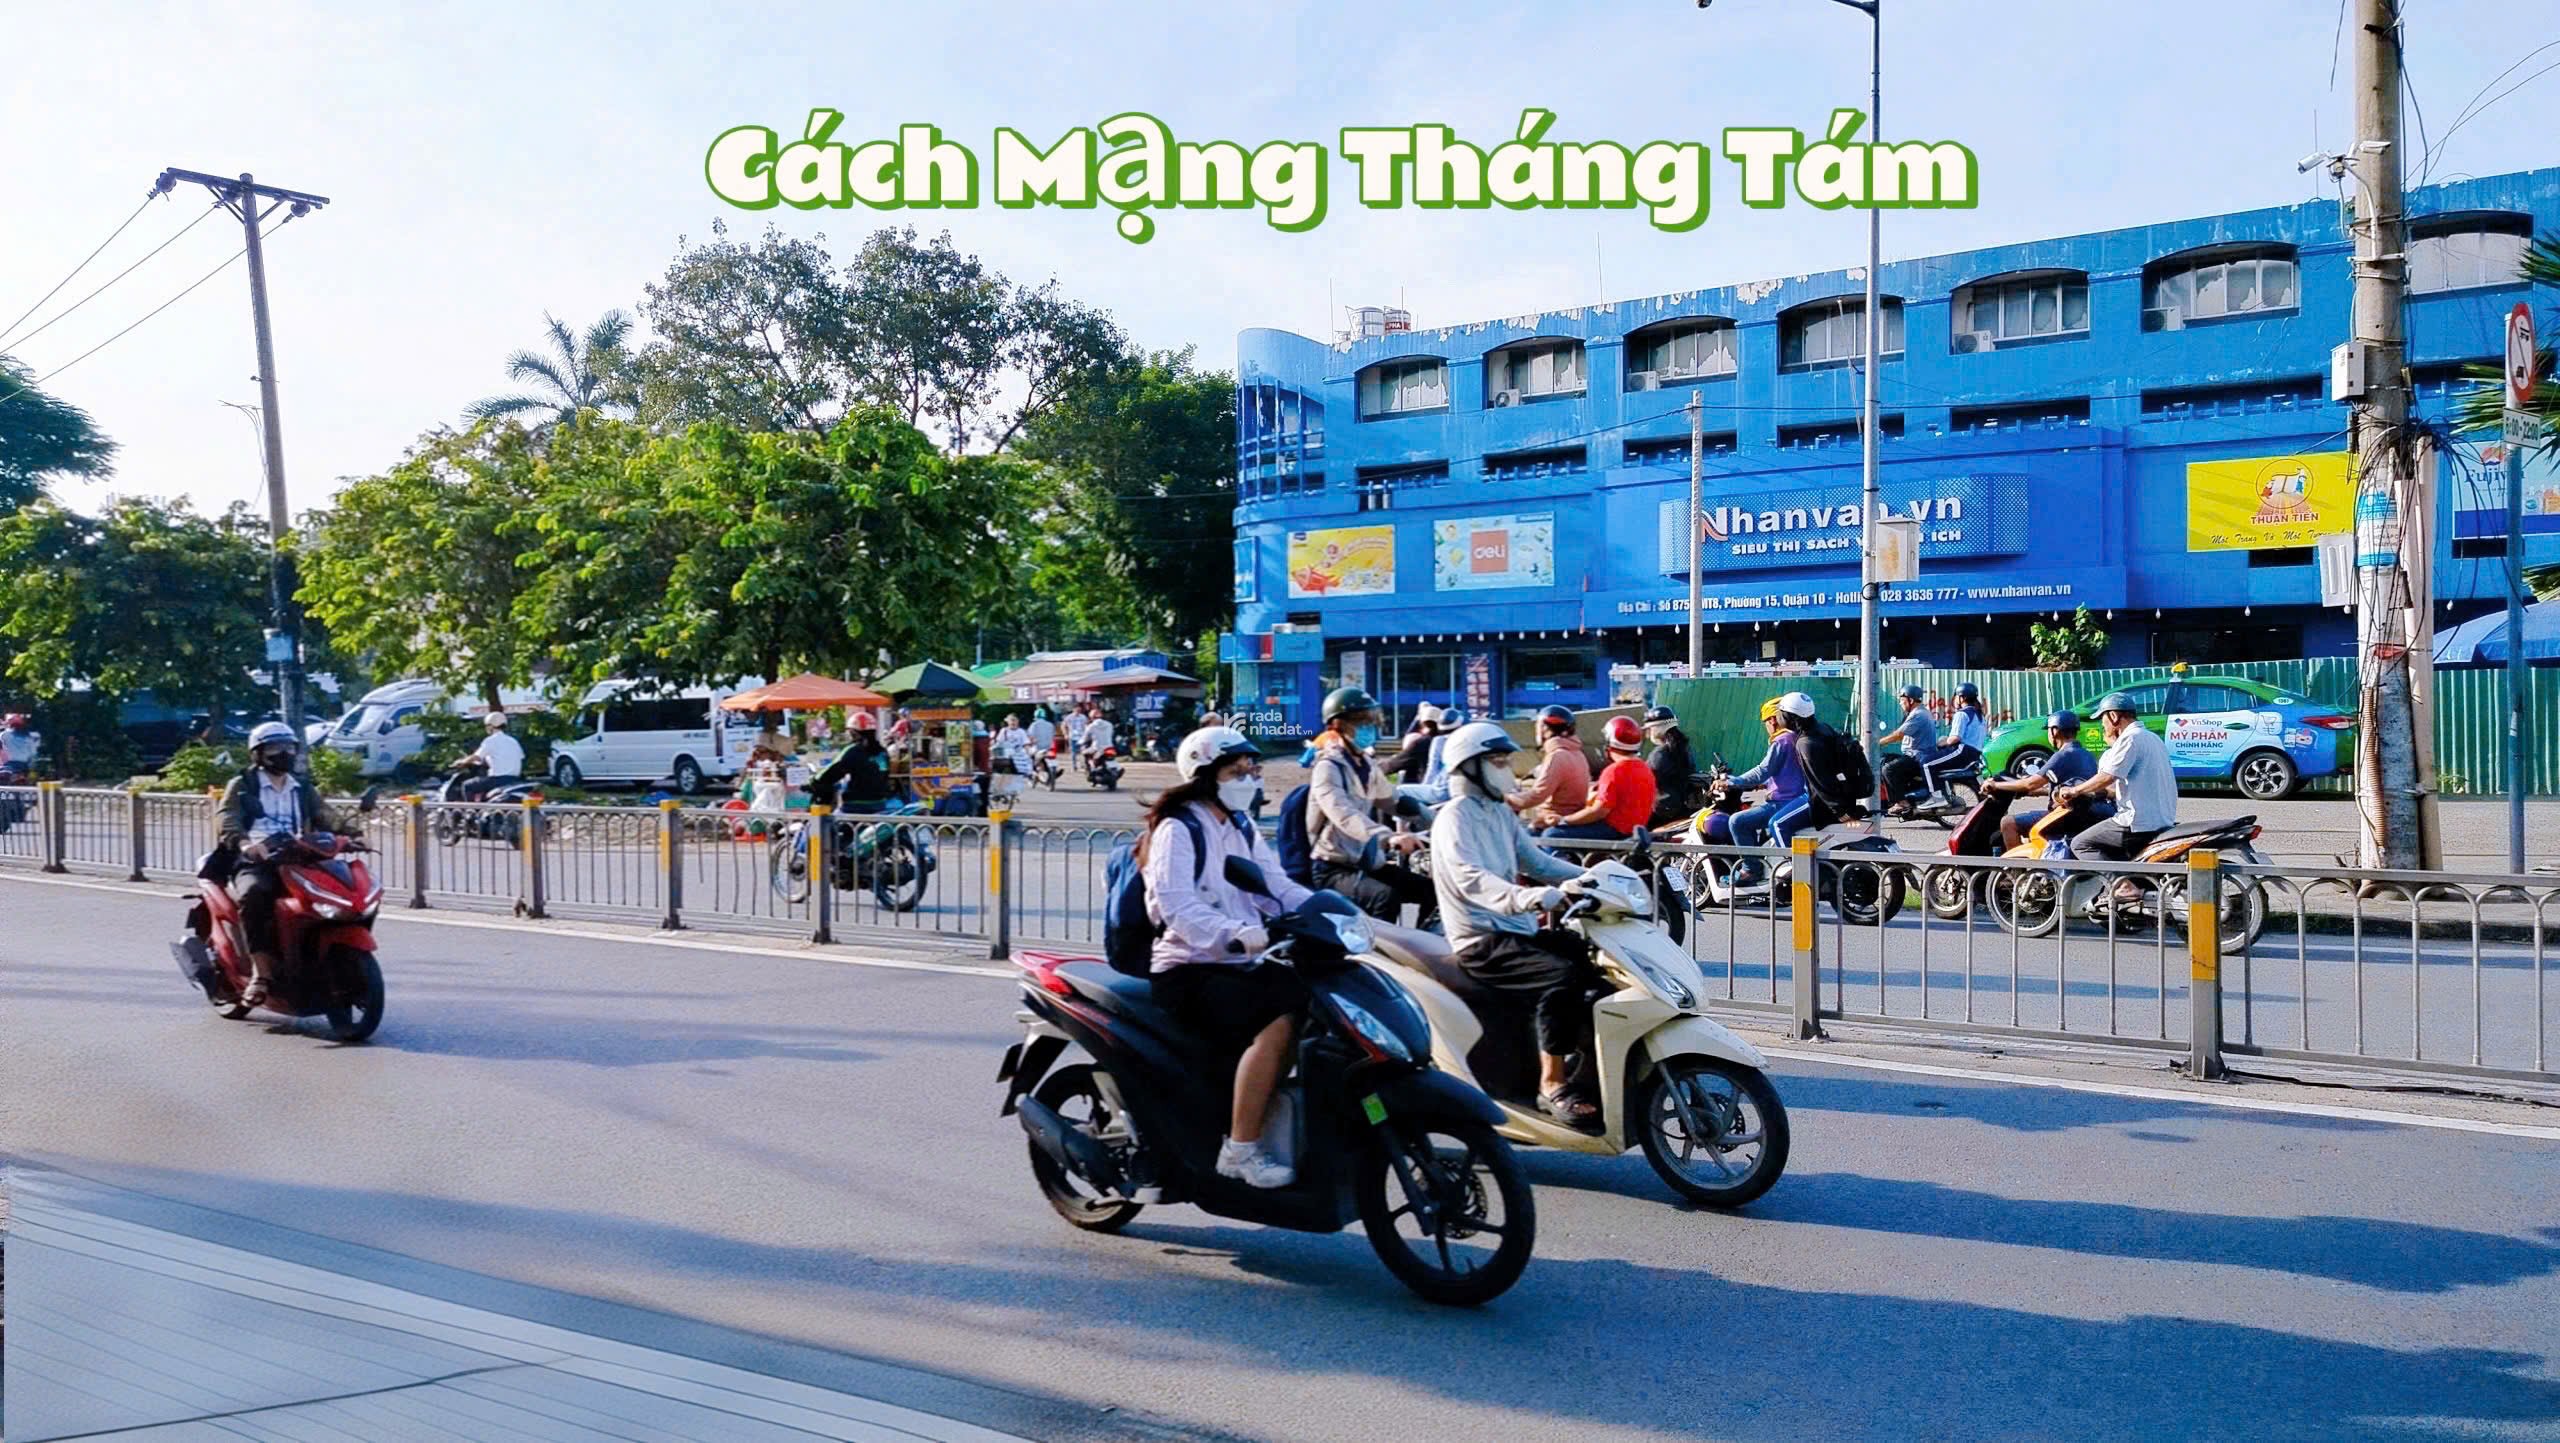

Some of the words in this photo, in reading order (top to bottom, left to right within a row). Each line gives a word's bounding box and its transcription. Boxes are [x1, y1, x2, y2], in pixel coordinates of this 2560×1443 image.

[1473, 544, 1505, 559] deli
[1725, 595, 1762, 609] Phường
[1764, 594, 1781, 607] 15,
[1782, 593, 1810, 608] Quận
[1812, 592, 1826, 605] 10
[1880, 589, 1902, 602] 028
[1904, 587, 1934, 600] 3636
[1967, 584, 2072, 599] www.nhanvan.vn
[2191, 719, 2222, 727] VnShop
[2170, 729, 2189, 740] MỸ
